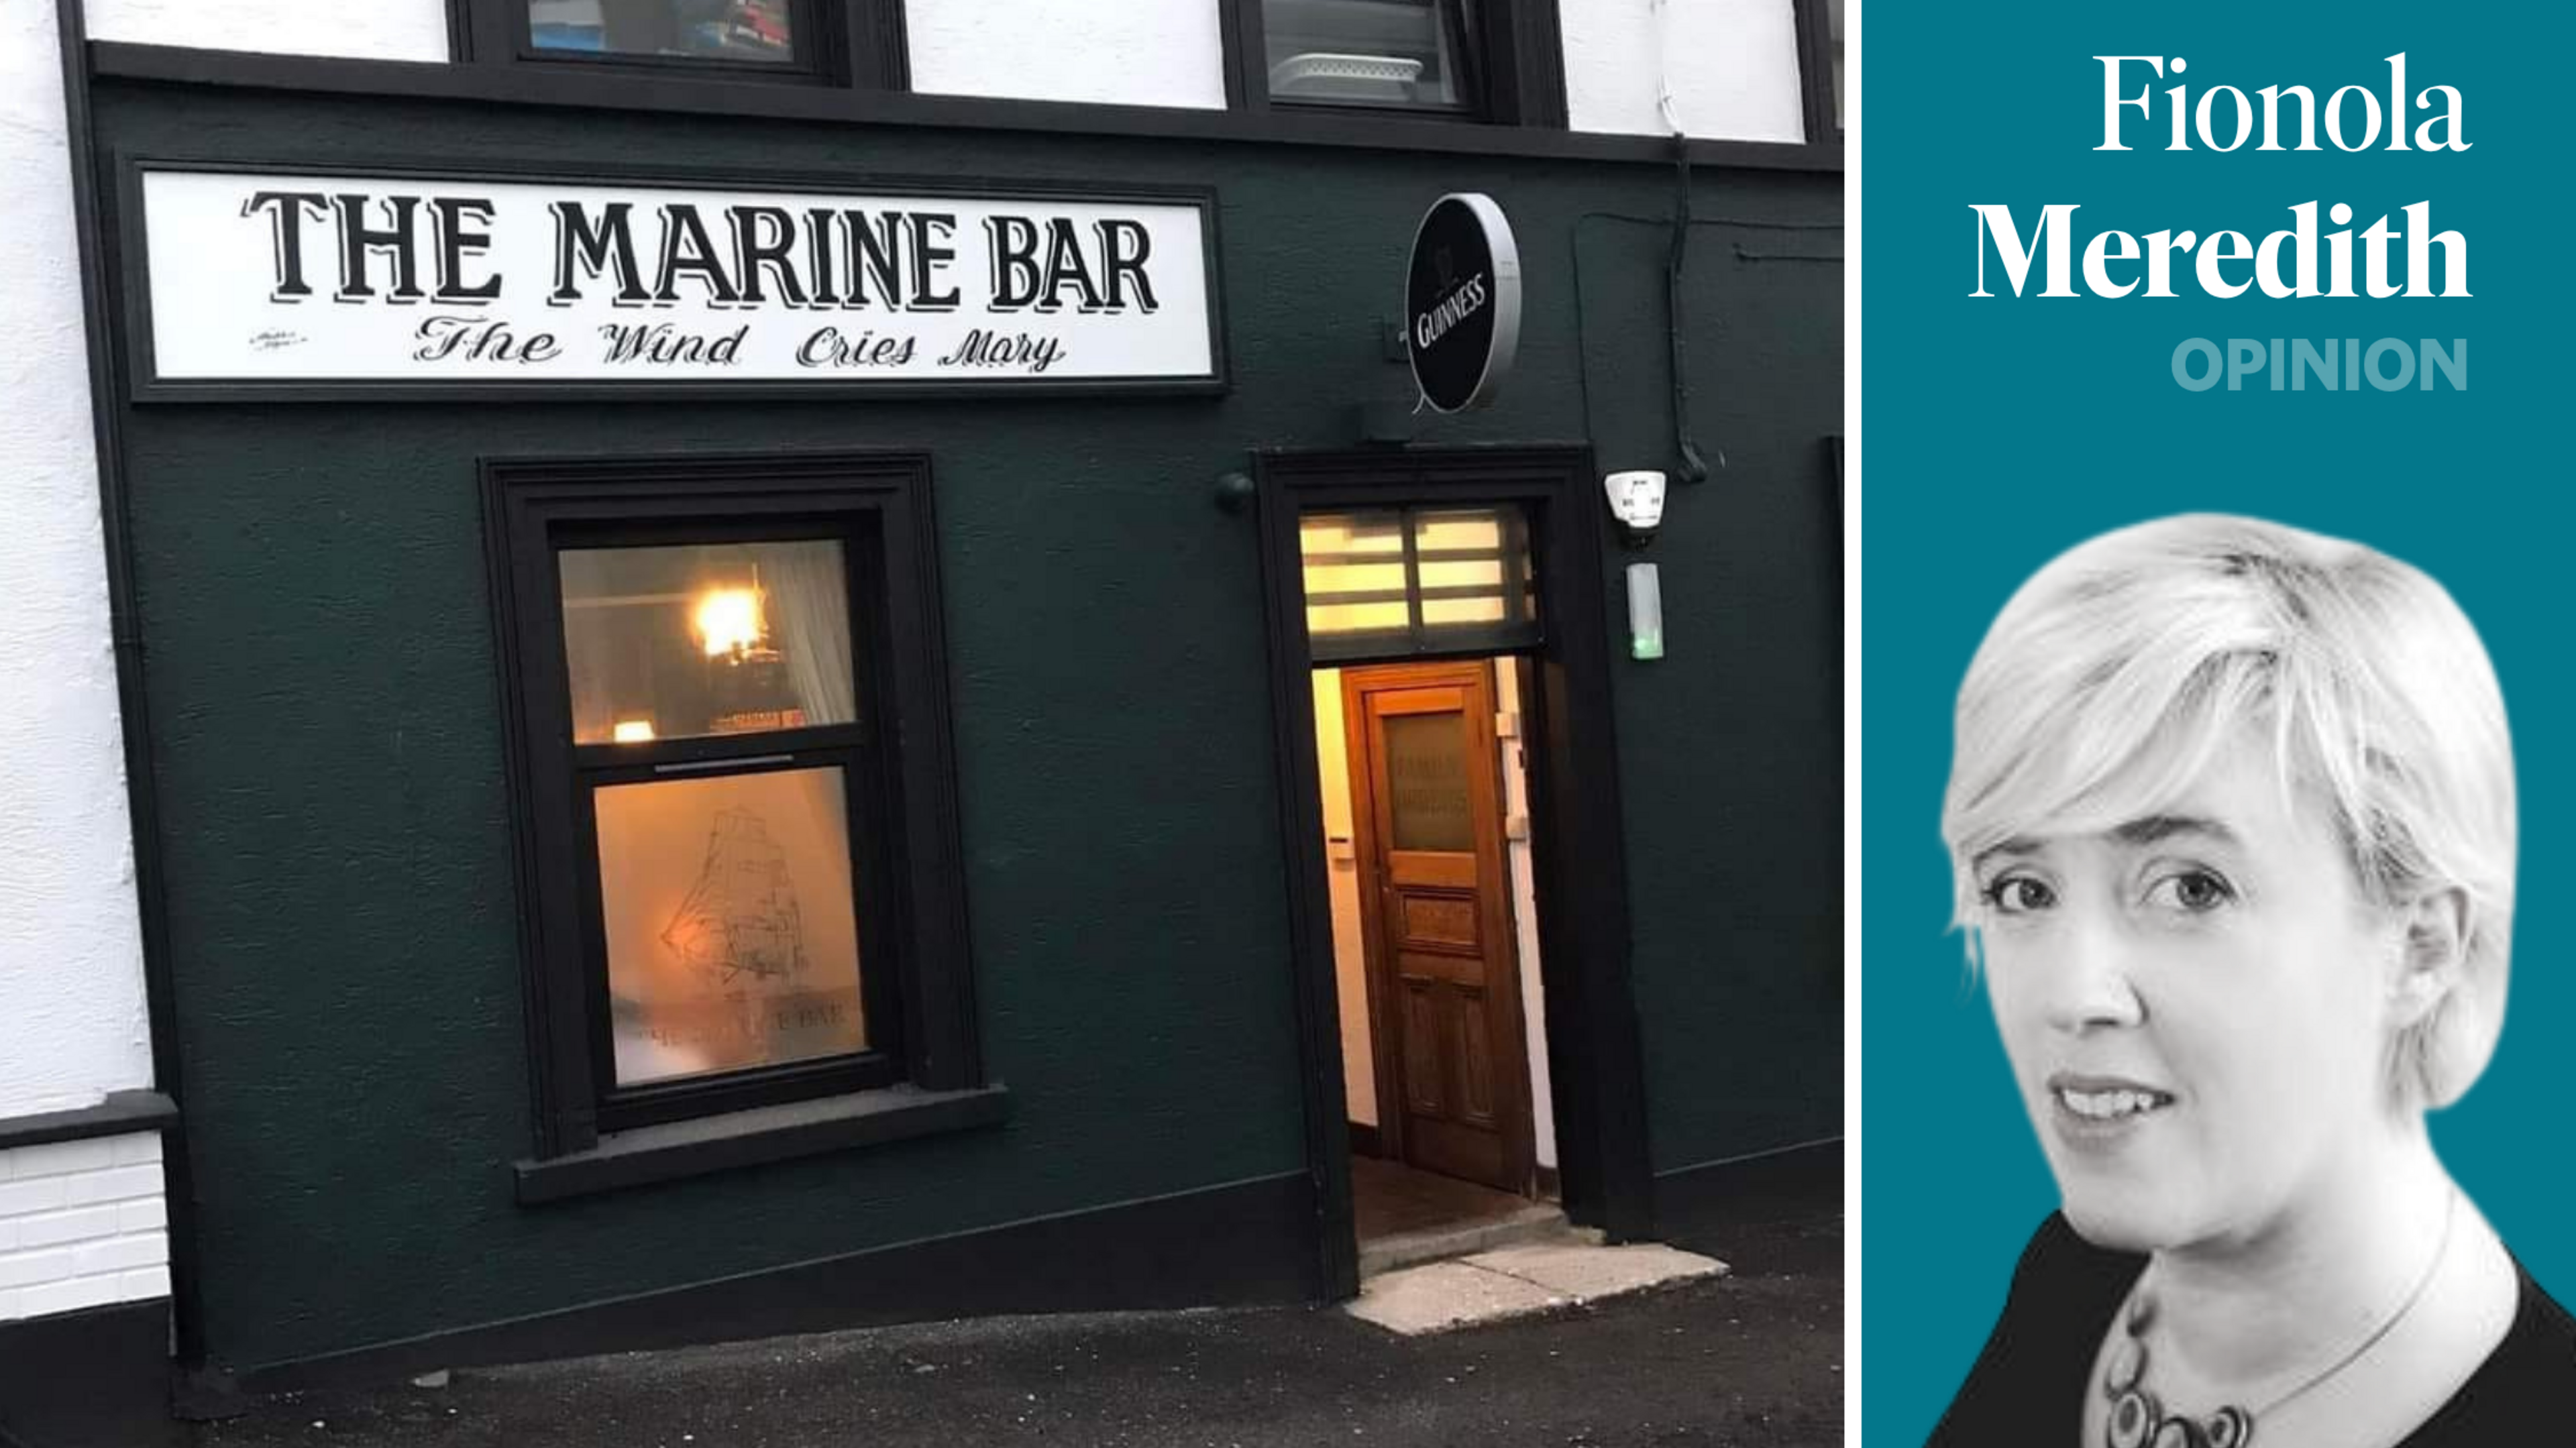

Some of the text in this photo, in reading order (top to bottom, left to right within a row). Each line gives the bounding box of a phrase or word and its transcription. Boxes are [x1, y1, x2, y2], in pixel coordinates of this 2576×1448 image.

[240, 191, 1159, 315] THE MARINE BAR
[413, 316, 1067, 373] The Wind Cries Mary
[1417, 272, 1485, 349] GUINNESS
